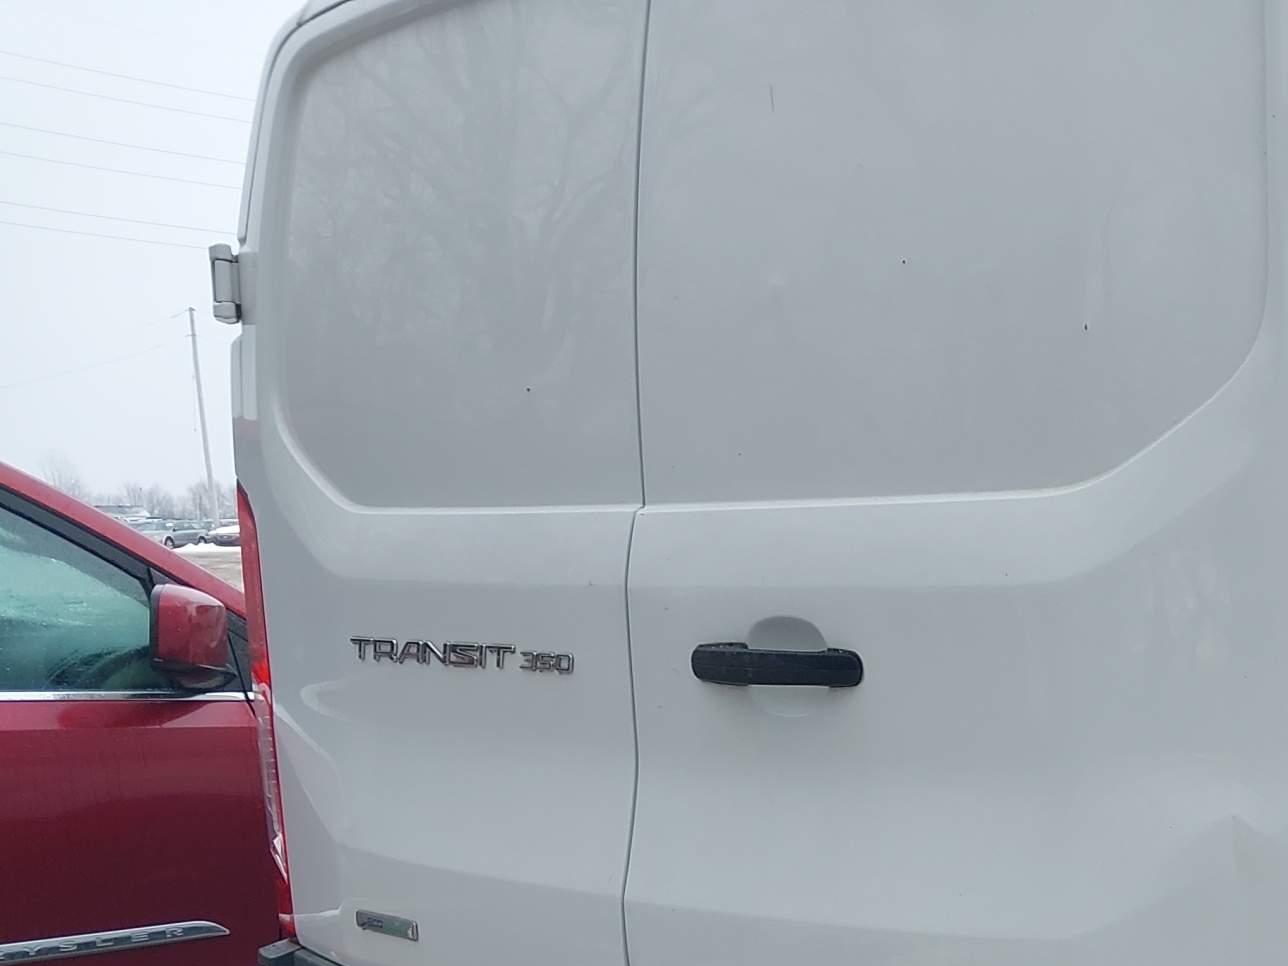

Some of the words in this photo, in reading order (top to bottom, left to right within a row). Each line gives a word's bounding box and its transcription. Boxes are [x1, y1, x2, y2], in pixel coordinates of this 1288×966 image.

[350, 636, 516, 670] TRANSIT
[519, 651, 575, 674] 350
[0, 926, 184, 960] YSLER
